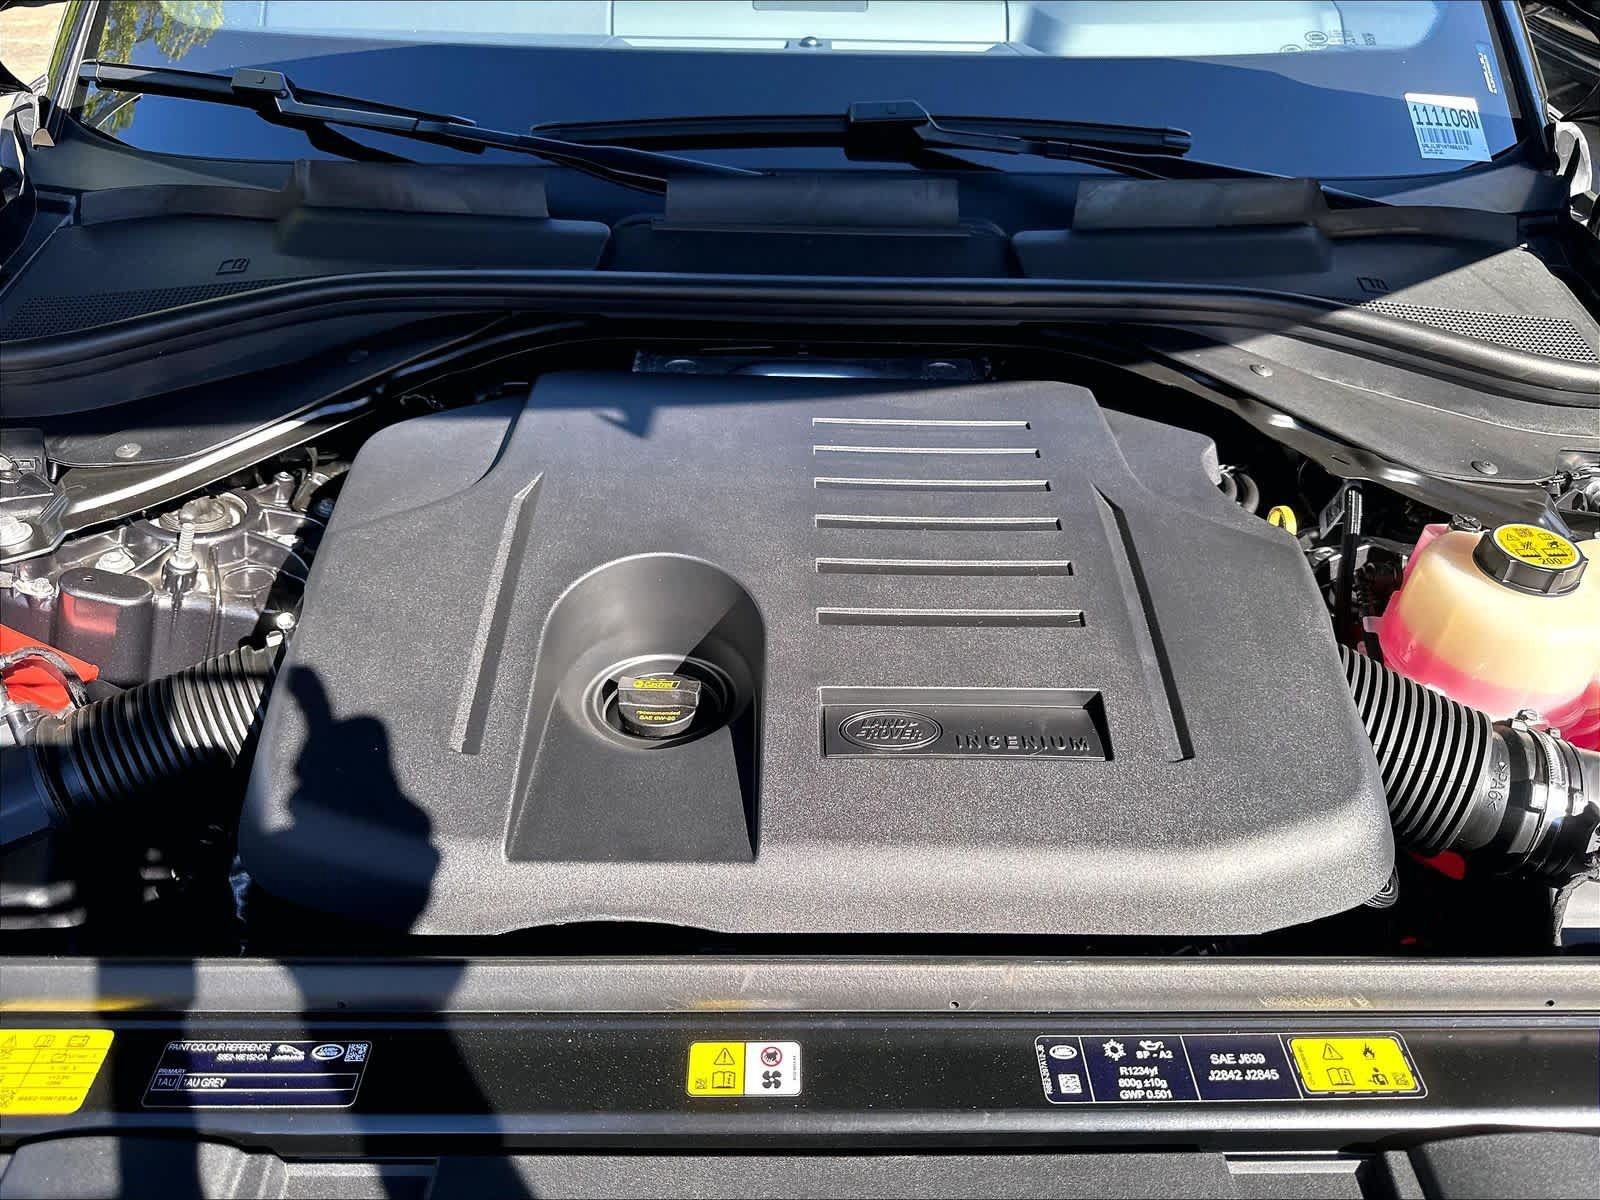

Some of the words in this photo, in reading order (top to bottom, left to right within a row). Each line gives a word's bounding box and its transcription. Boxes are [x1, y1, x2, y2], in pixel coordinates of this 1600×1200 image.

[1412, 105, 1479, 129] 111106N
[860, 718, 908, 730] LAND
[865, 729, 924, 741] ROVER
[955, 734, 1091, 752] INGENIUM
[167, 1043, 190, 1052] PAINT
[190, 1043, 225, 1053] COLOUR
[225, 1043, 272, 1053] REFERENCE
[1159, 1050, 1173, 1059] A2
[1209, 1053, 1237, 1065] SAE
[1238, 1053, 1266, 1064] J639
[1208, 1069, 1243, 1081] J2842
[1244, 1069, 1280, 1080] J2845
[183, 1078, 200, 1088] 1AU
[200, 1077, 227, 1088] GREY
[1118, 1078, 1143, 1089] 800g
[1120, 1090, 1145, 1100] GWP
[1146, 1089, 1173, 1099] 0.501
